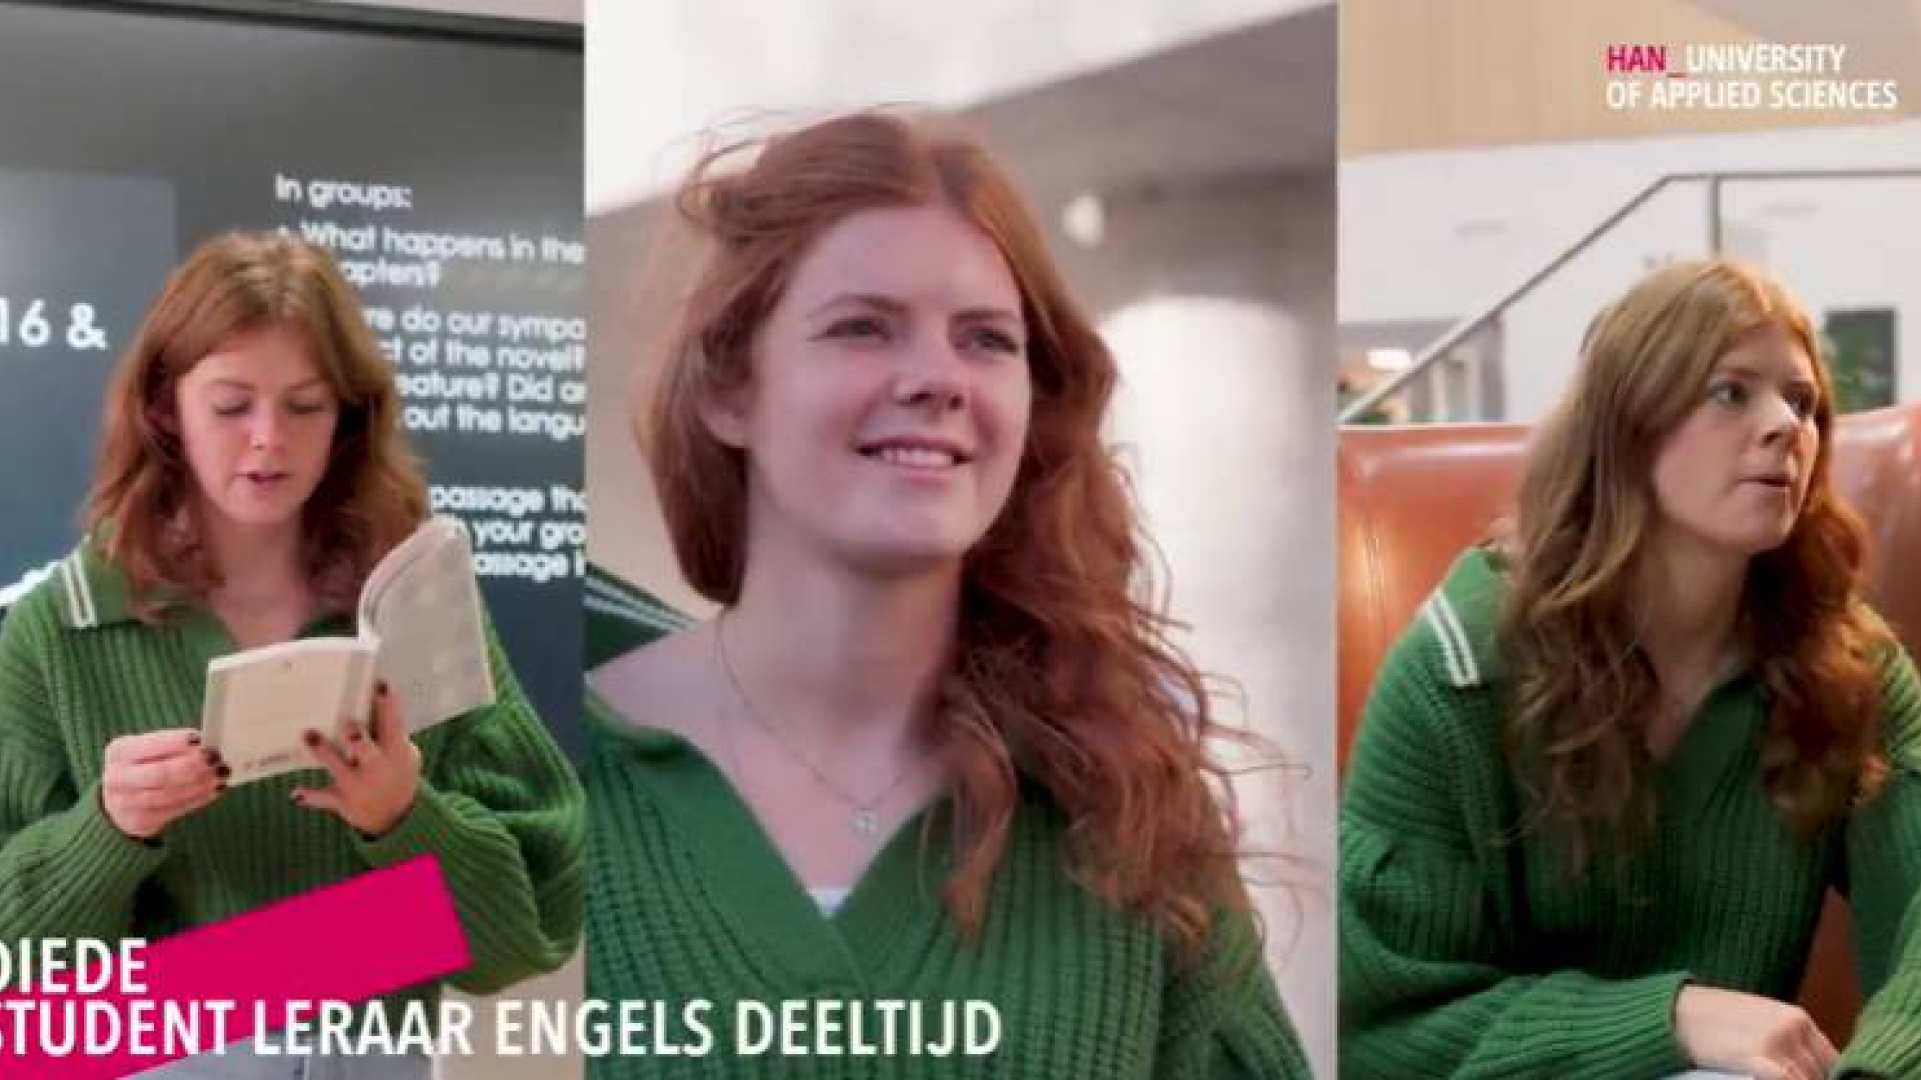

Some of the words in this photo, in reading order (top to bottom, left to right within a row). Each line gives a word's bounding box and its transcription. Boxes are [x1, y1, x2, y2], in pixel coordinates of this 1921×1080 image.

[275, 172, 301, 200] In
[308, 179, 414, 210] groups:
[301, 220, 375, 250] What
[383, 224, 504, 260] happens
[510, 232, 536, 258] in
[541, 235, 584, 263] the
[66, 302, 107, 349] &
[401, 304, 441, 332] do
[446, 310, 492, 335] our
[408, 336, 438, 363] of
[446, 338, 491, 367] the
[507, 373, 553, 402] Did
[457, 403, 503, 432] the
[430, 485, 544, 517] passage
[471, 520, 533, 548] your
